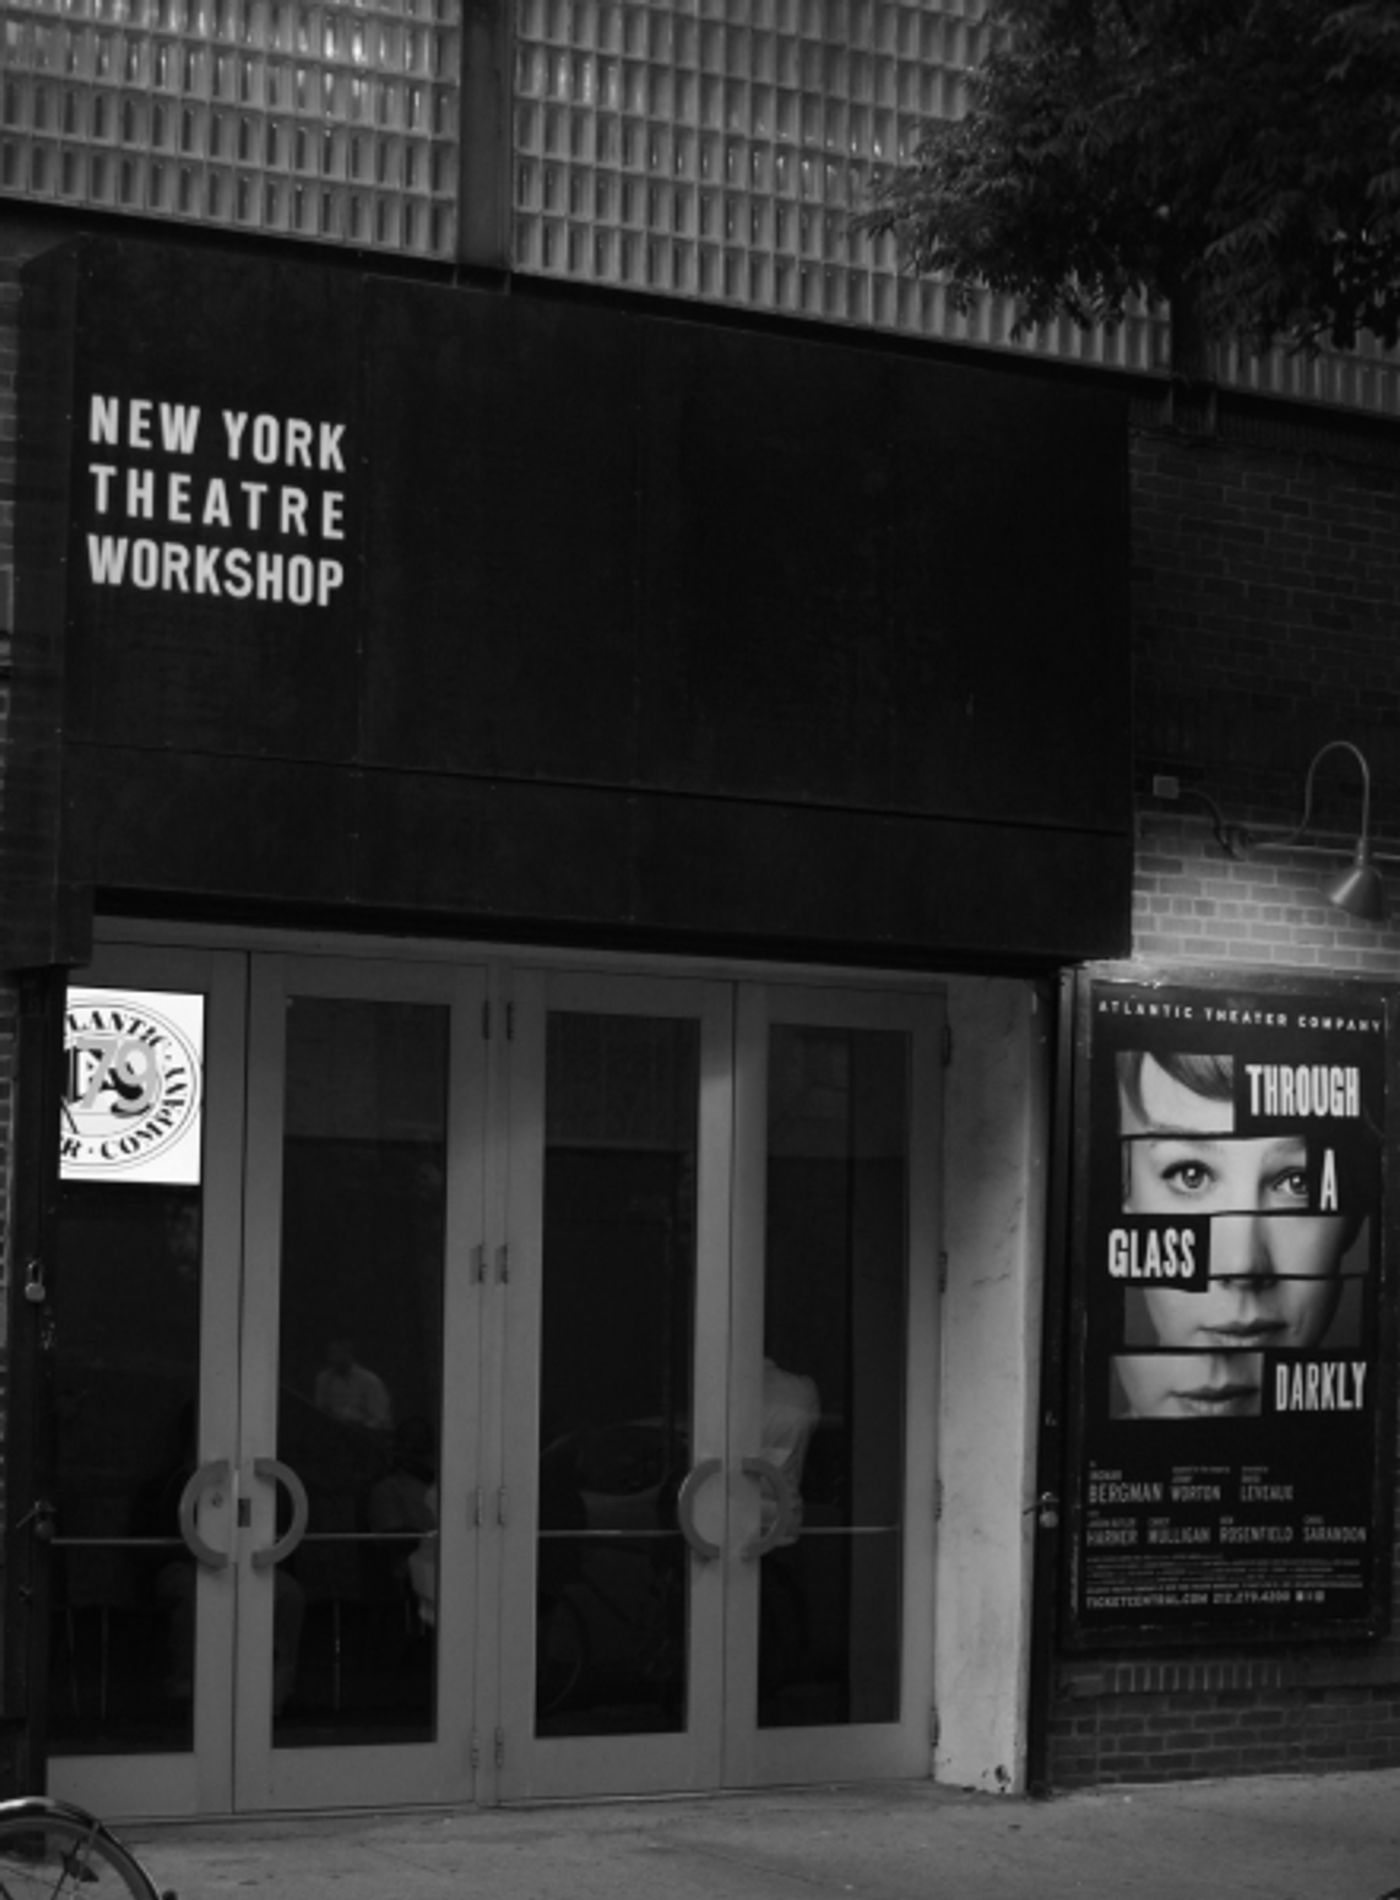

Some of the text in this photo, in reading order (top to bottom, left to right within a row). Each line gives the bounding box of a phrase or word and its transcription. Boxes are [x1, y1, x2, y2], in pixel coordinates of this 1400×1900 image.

[89, 394, 346, 473] NEW YORK
[88, 463, 346, 541] THEATRE
[87, 533, 345, 607] WORKSHOP
[67, 1010, 165, 1047] LANTIC
[1098, 1000, 1380, 1033] ATLANTIC THEATER COMPANY
[1244, 1063, 1360, 1117] THROUGH
[1320, 1148, 1338, 1211] A
[1108, 1227, 1196, 1279] GLASS
[1275, 1361, 1367, 1412] DARKLY
[1089, 1481, 1163, 1503] BERGMAN
[1148, 1526, 1211, 1544] MULLIGAN
[1303, 1525, 1367, 1544] SARANDON
